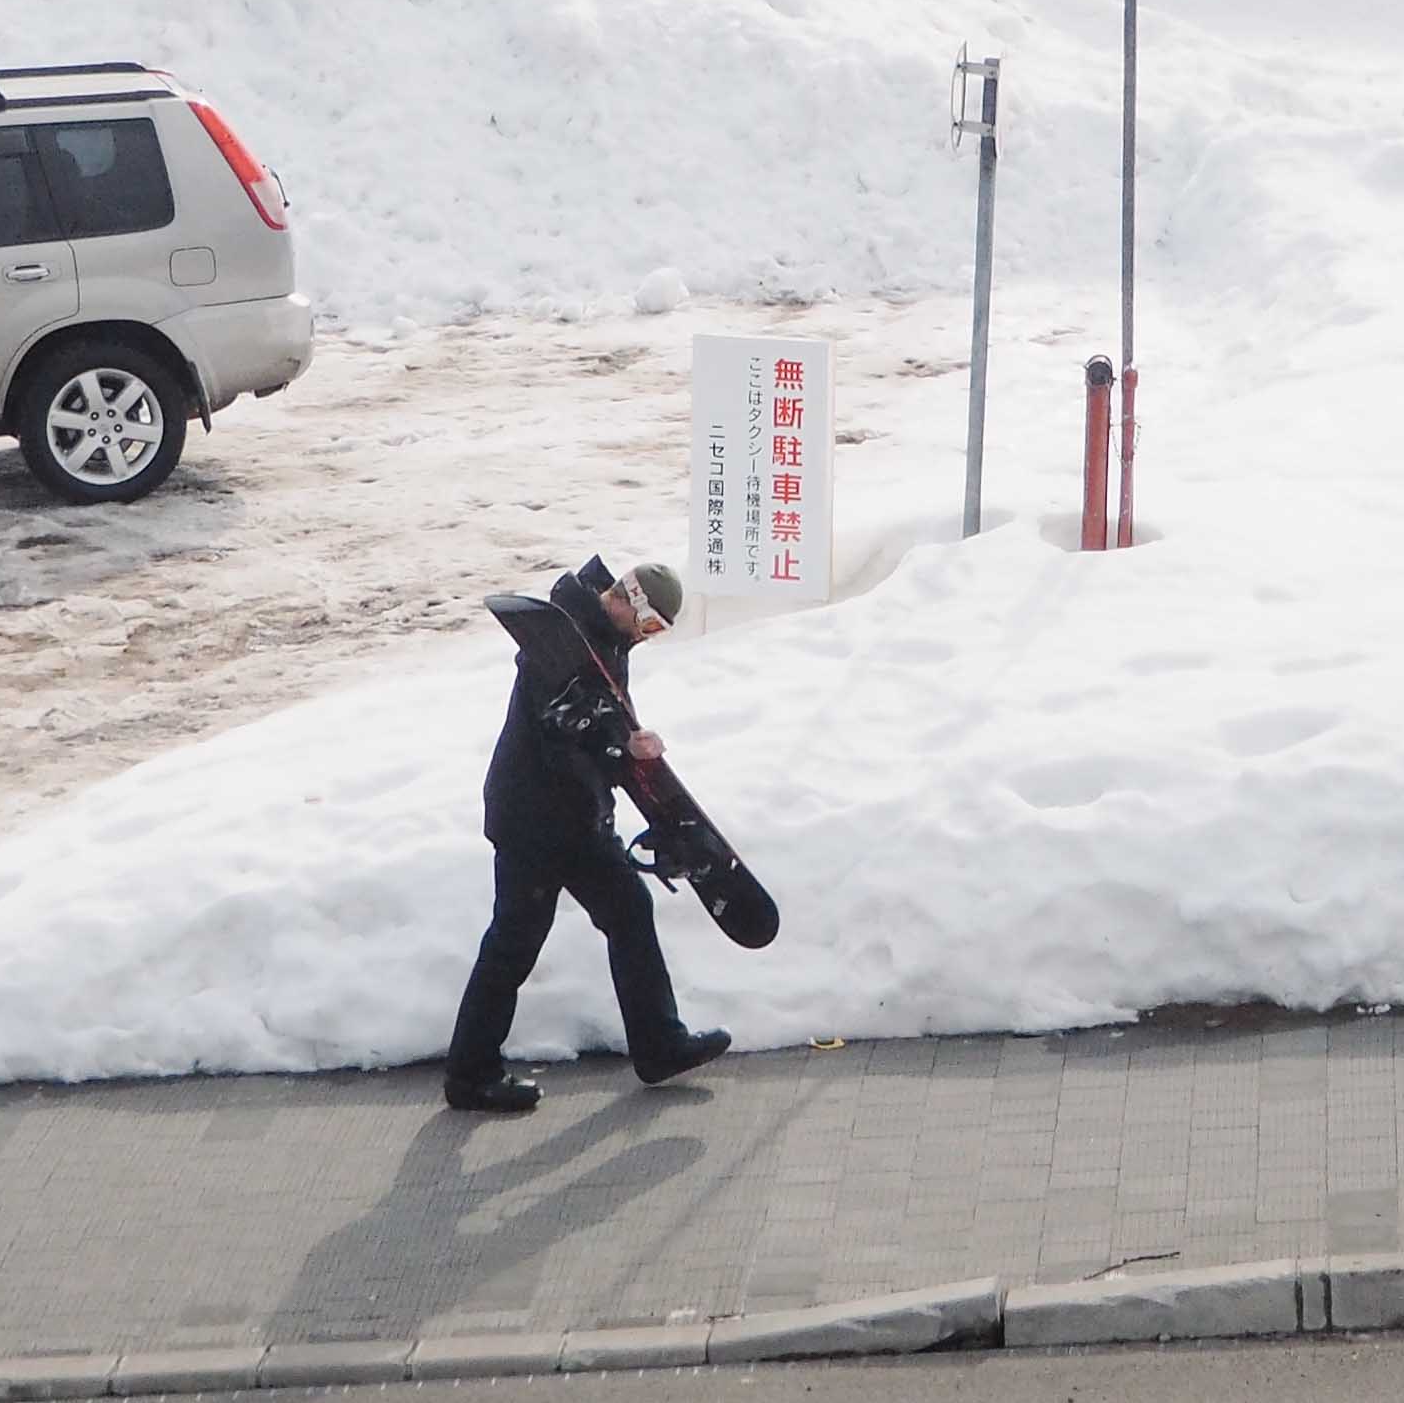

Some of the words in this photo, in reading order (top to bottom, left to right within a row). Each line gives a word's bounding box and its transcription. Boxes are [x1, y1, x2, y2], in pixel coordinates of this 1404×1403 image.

[770, 358, 804, 581] 無断駐車禁止
